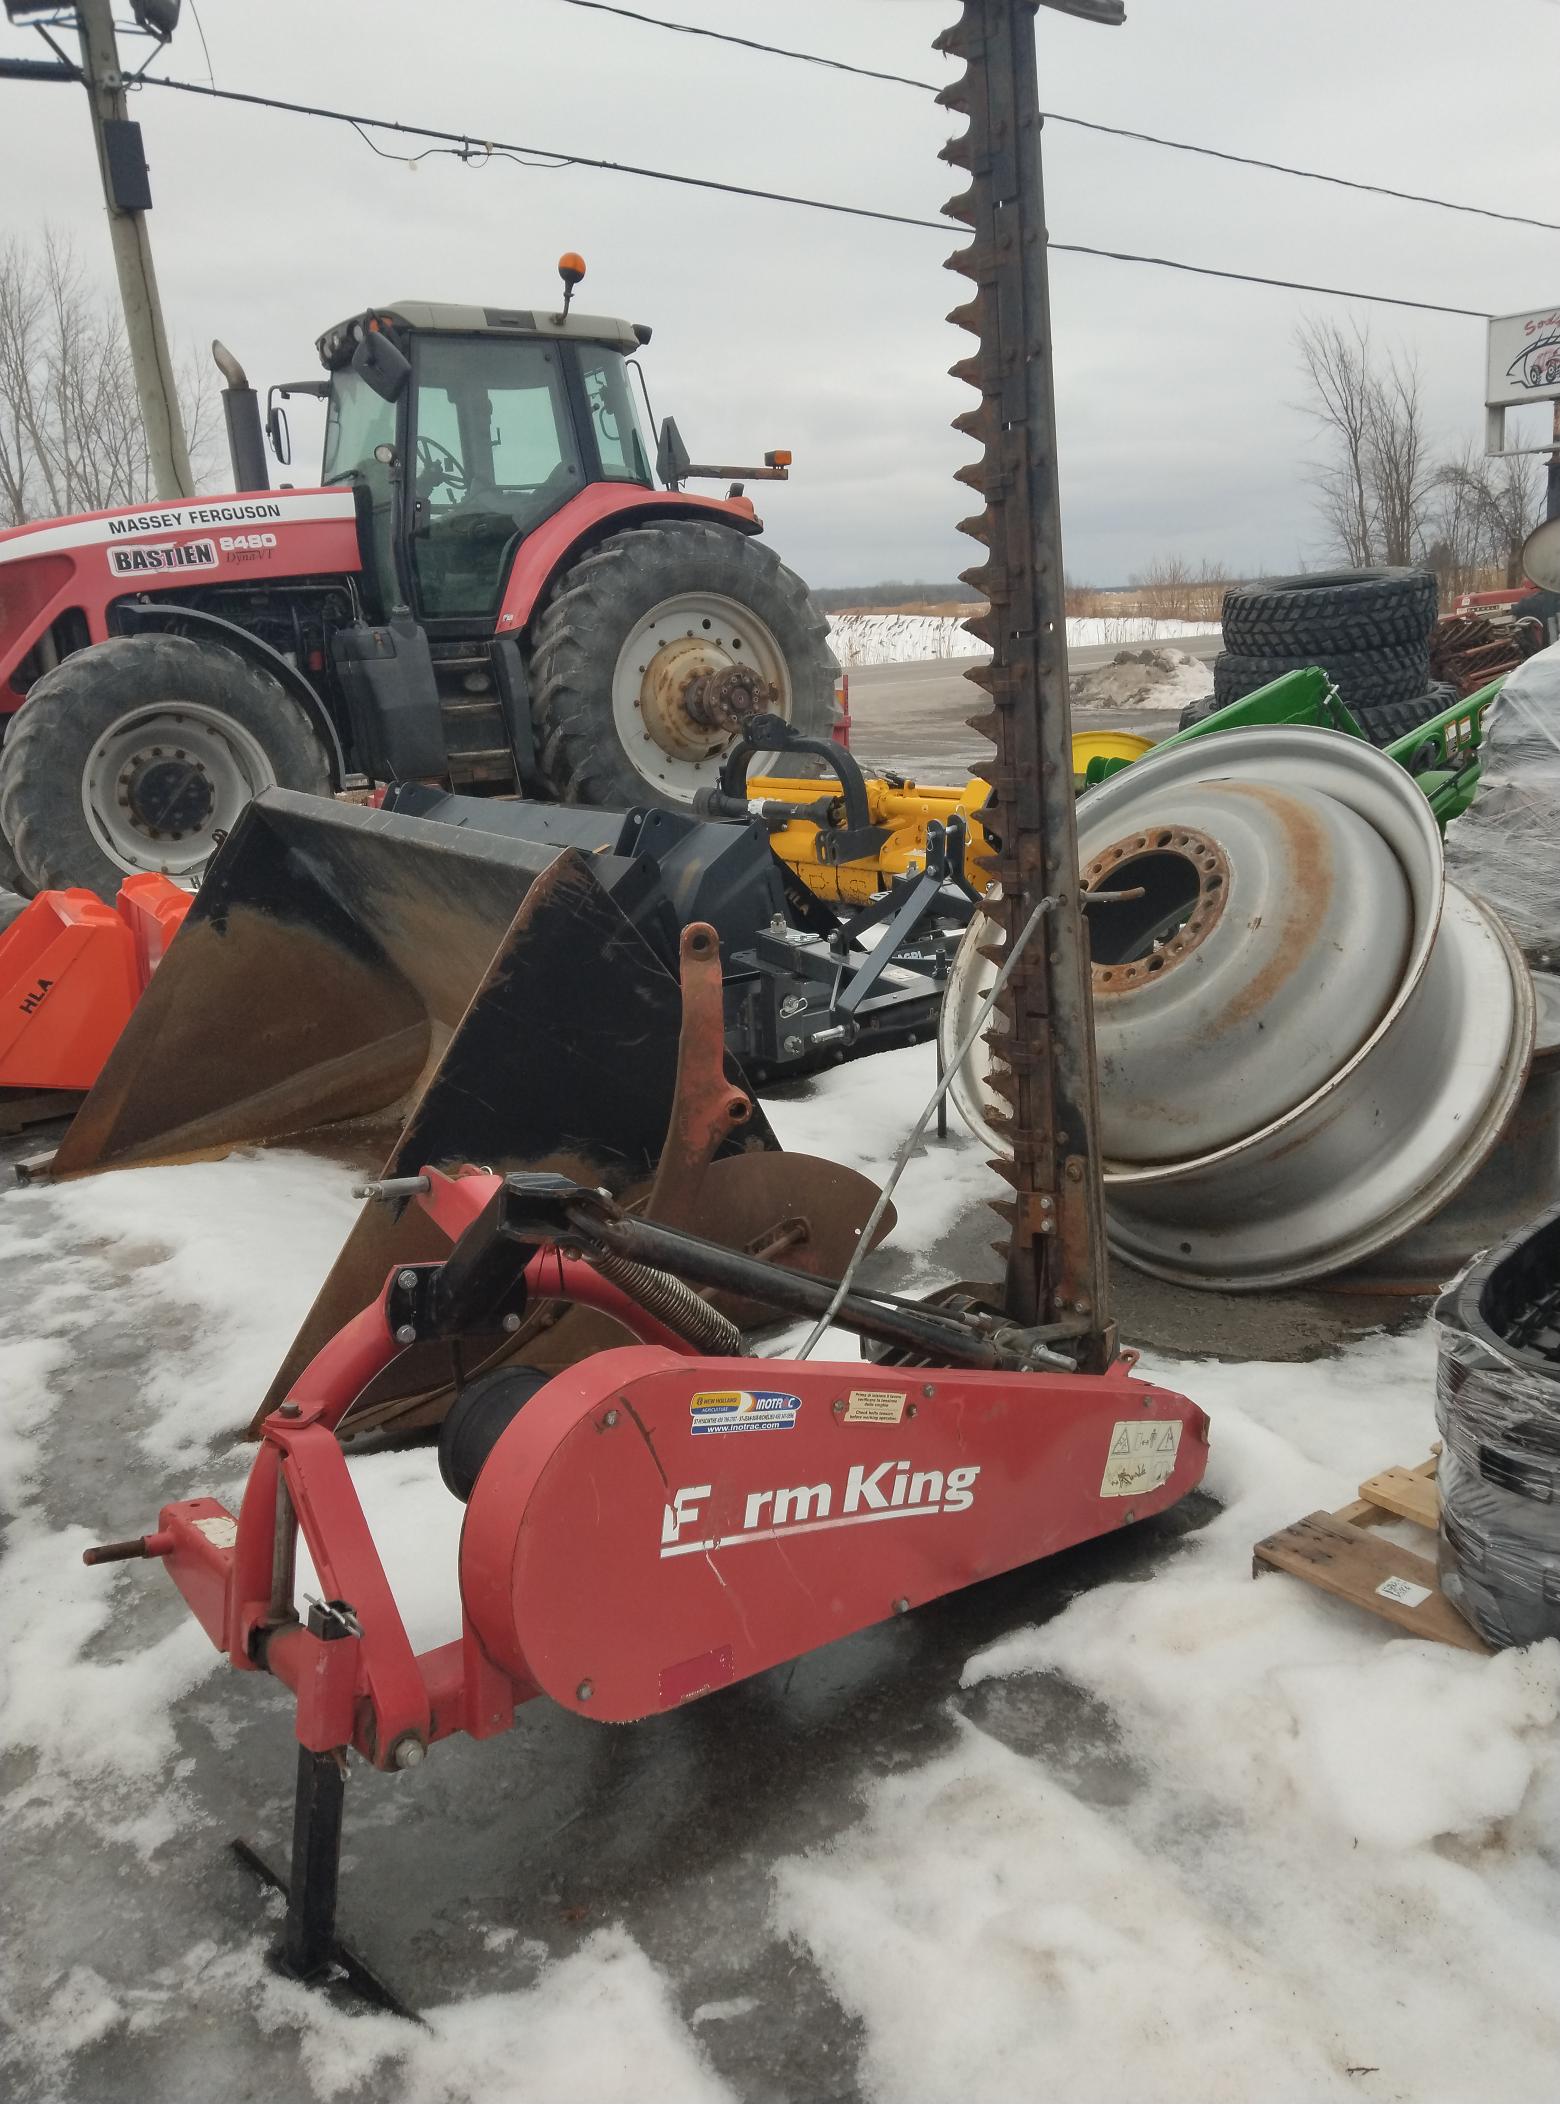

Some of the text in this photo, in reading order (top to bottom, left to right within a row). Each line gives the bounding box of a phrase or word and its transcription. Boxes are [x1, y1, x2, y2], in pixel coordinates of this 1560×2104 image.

[107, 504, 281, 535] MASSEY FERGUSON
[219, 533, 277, 551] 8480
[113, 543, 212, 571] BASTIEN
[19, 977, 54, 1014] HLA
[707, 1423, 779, 1432] www.inotrac.com
[661, 1460, 981, 1544] Frm King
